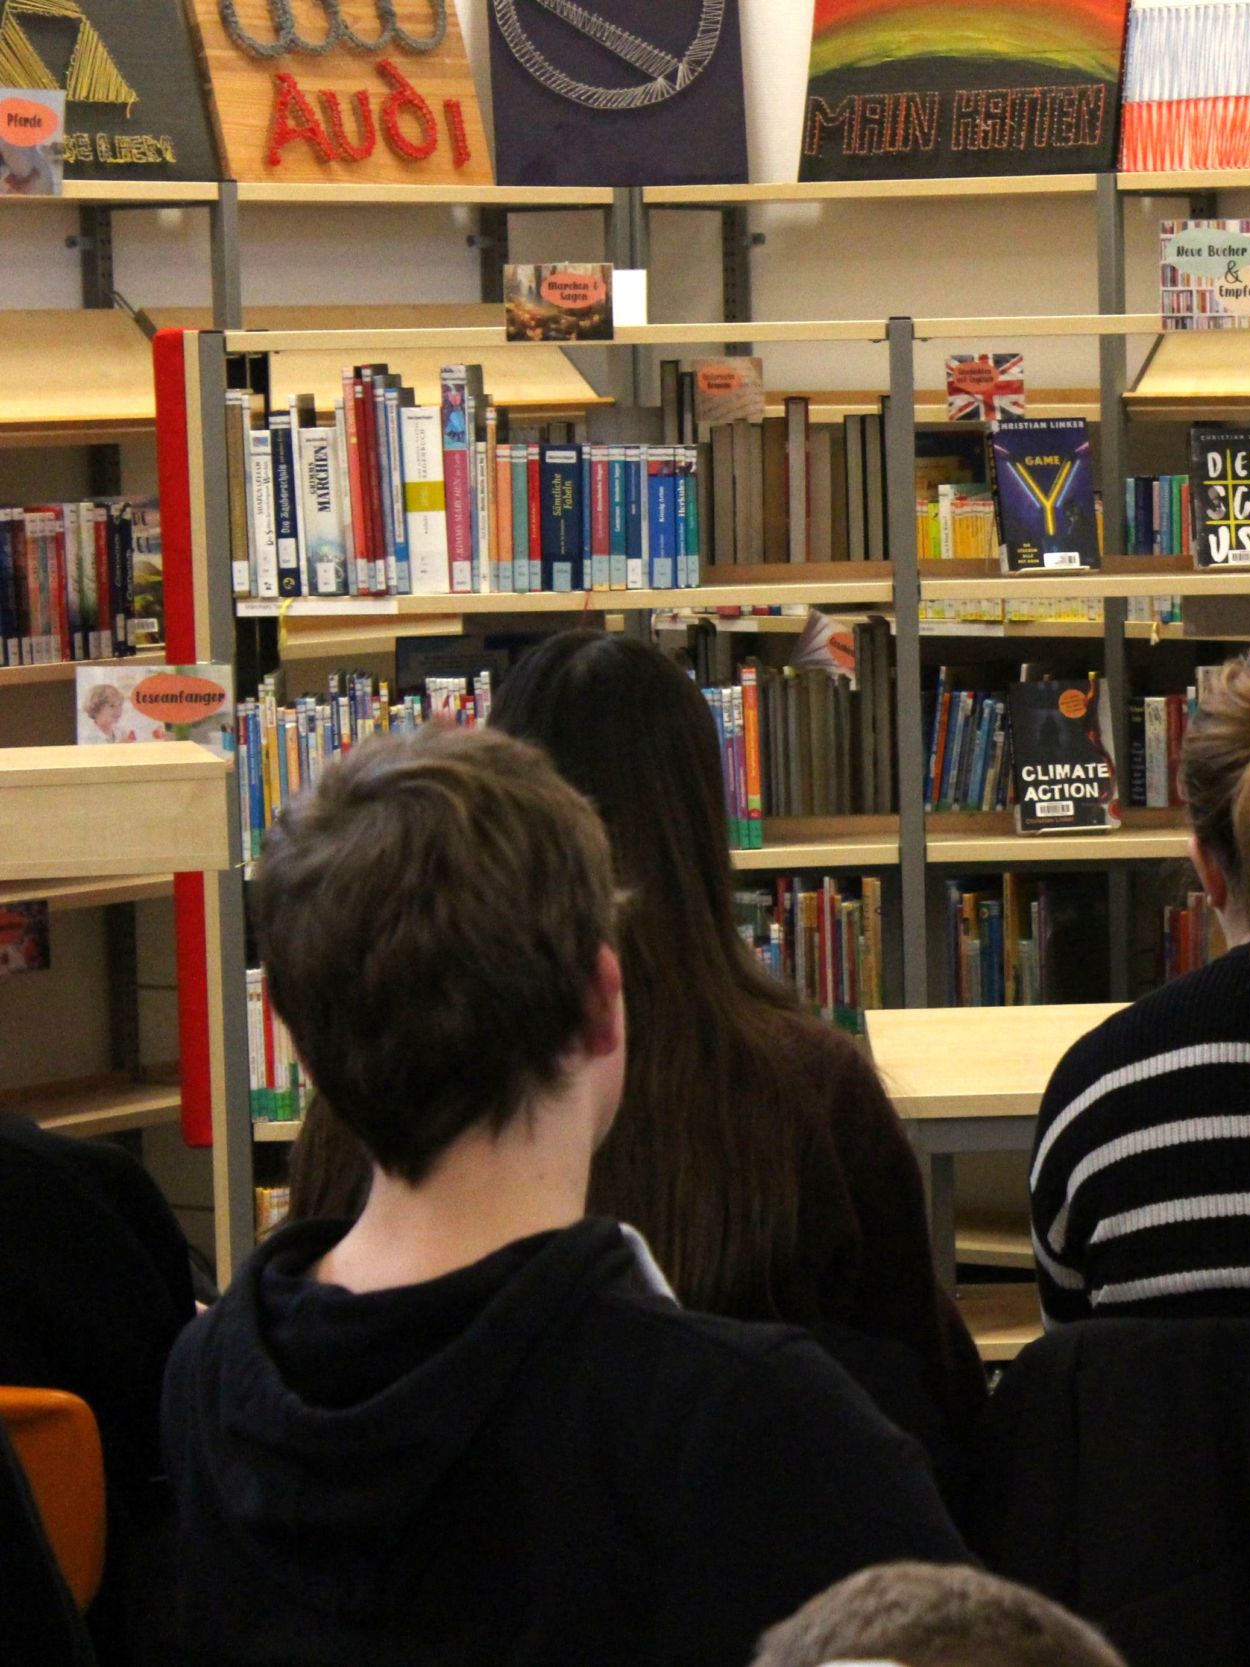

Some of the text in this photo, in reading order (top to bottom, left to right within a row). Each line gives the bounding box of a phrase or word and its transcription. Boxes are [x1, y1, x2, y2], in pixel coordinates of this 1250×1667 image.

[7, 112, 43, 128] Pferde
[267, 58, 472, 168] AUDI
[804, 92, 940, 155] MAIN
[1176, 246, 1202, 257] Neue
[1224, 260, 1243, 284] &
[1024, 455, 1062, 466] GAME
[308, 461, 317, 495] GRIMMS
[552, 473, 562, 516] Sämtliche
[563, 480, 573, 509] Fabeln
[677, 479, 686, 517] Herkules
[1021, 763, 1111, 782] CLIMATE
[1024, 782, 1099, 801] ACTION
